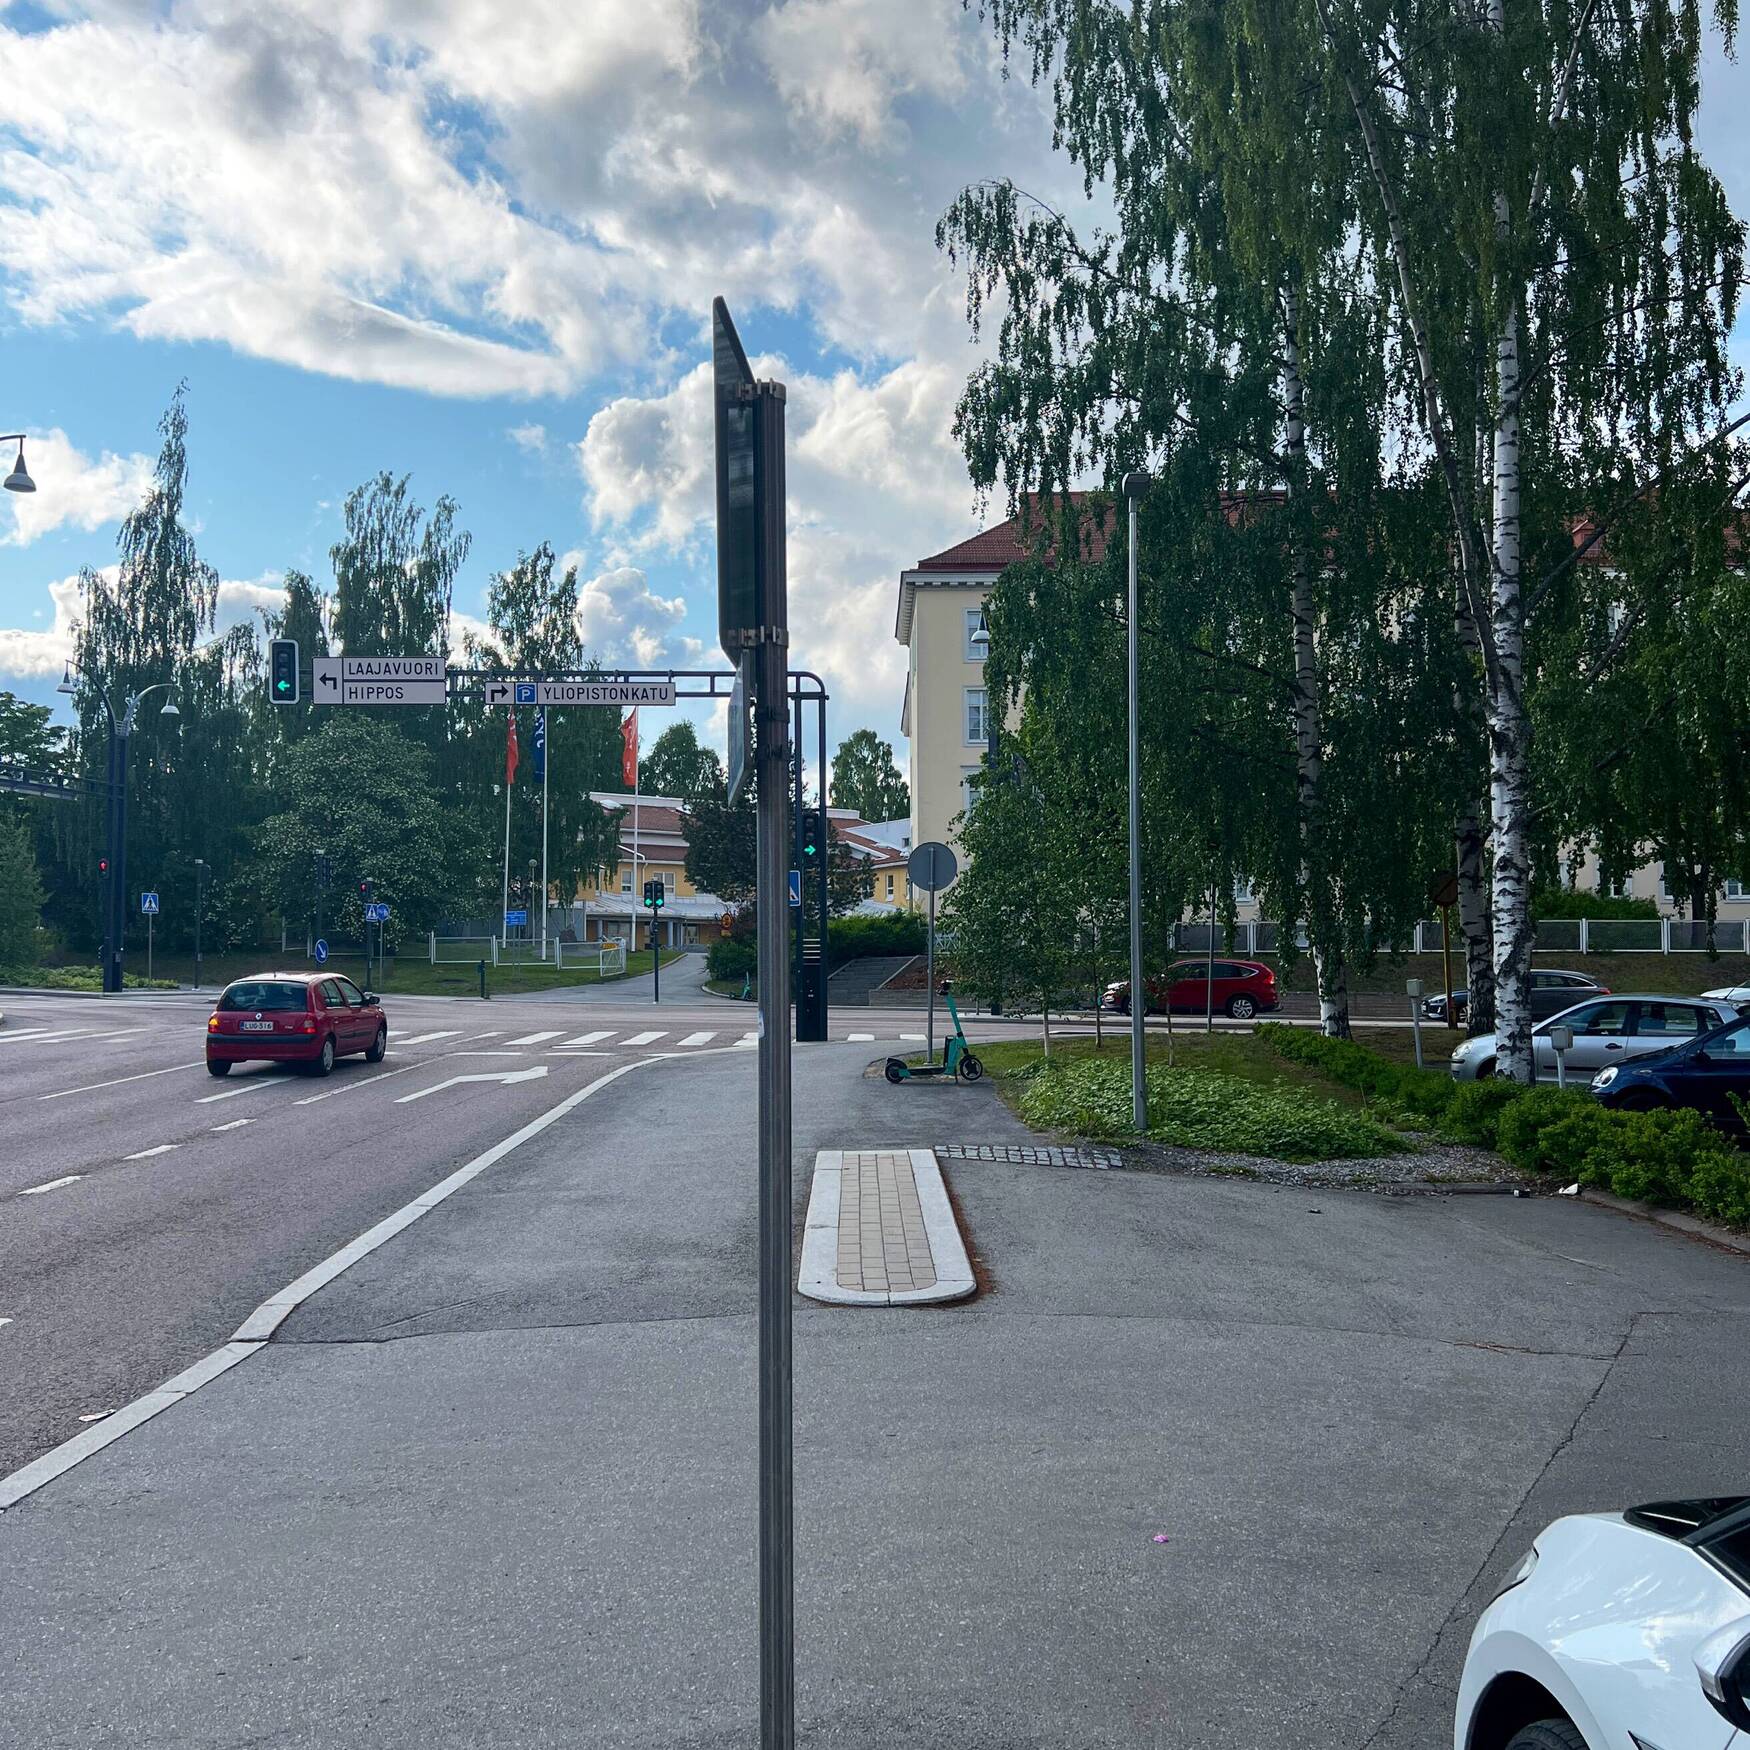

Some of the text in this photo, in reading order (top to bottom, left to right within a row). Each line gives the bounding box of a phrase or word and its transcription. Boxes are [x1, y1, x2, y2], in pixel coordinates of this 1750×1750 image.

[348, 662, 439, 675] LAAJAVUORI
[348, 686, 405, 699] HIPPOS
[521, 687, 669, 701] P YLIOPISTONKATU
